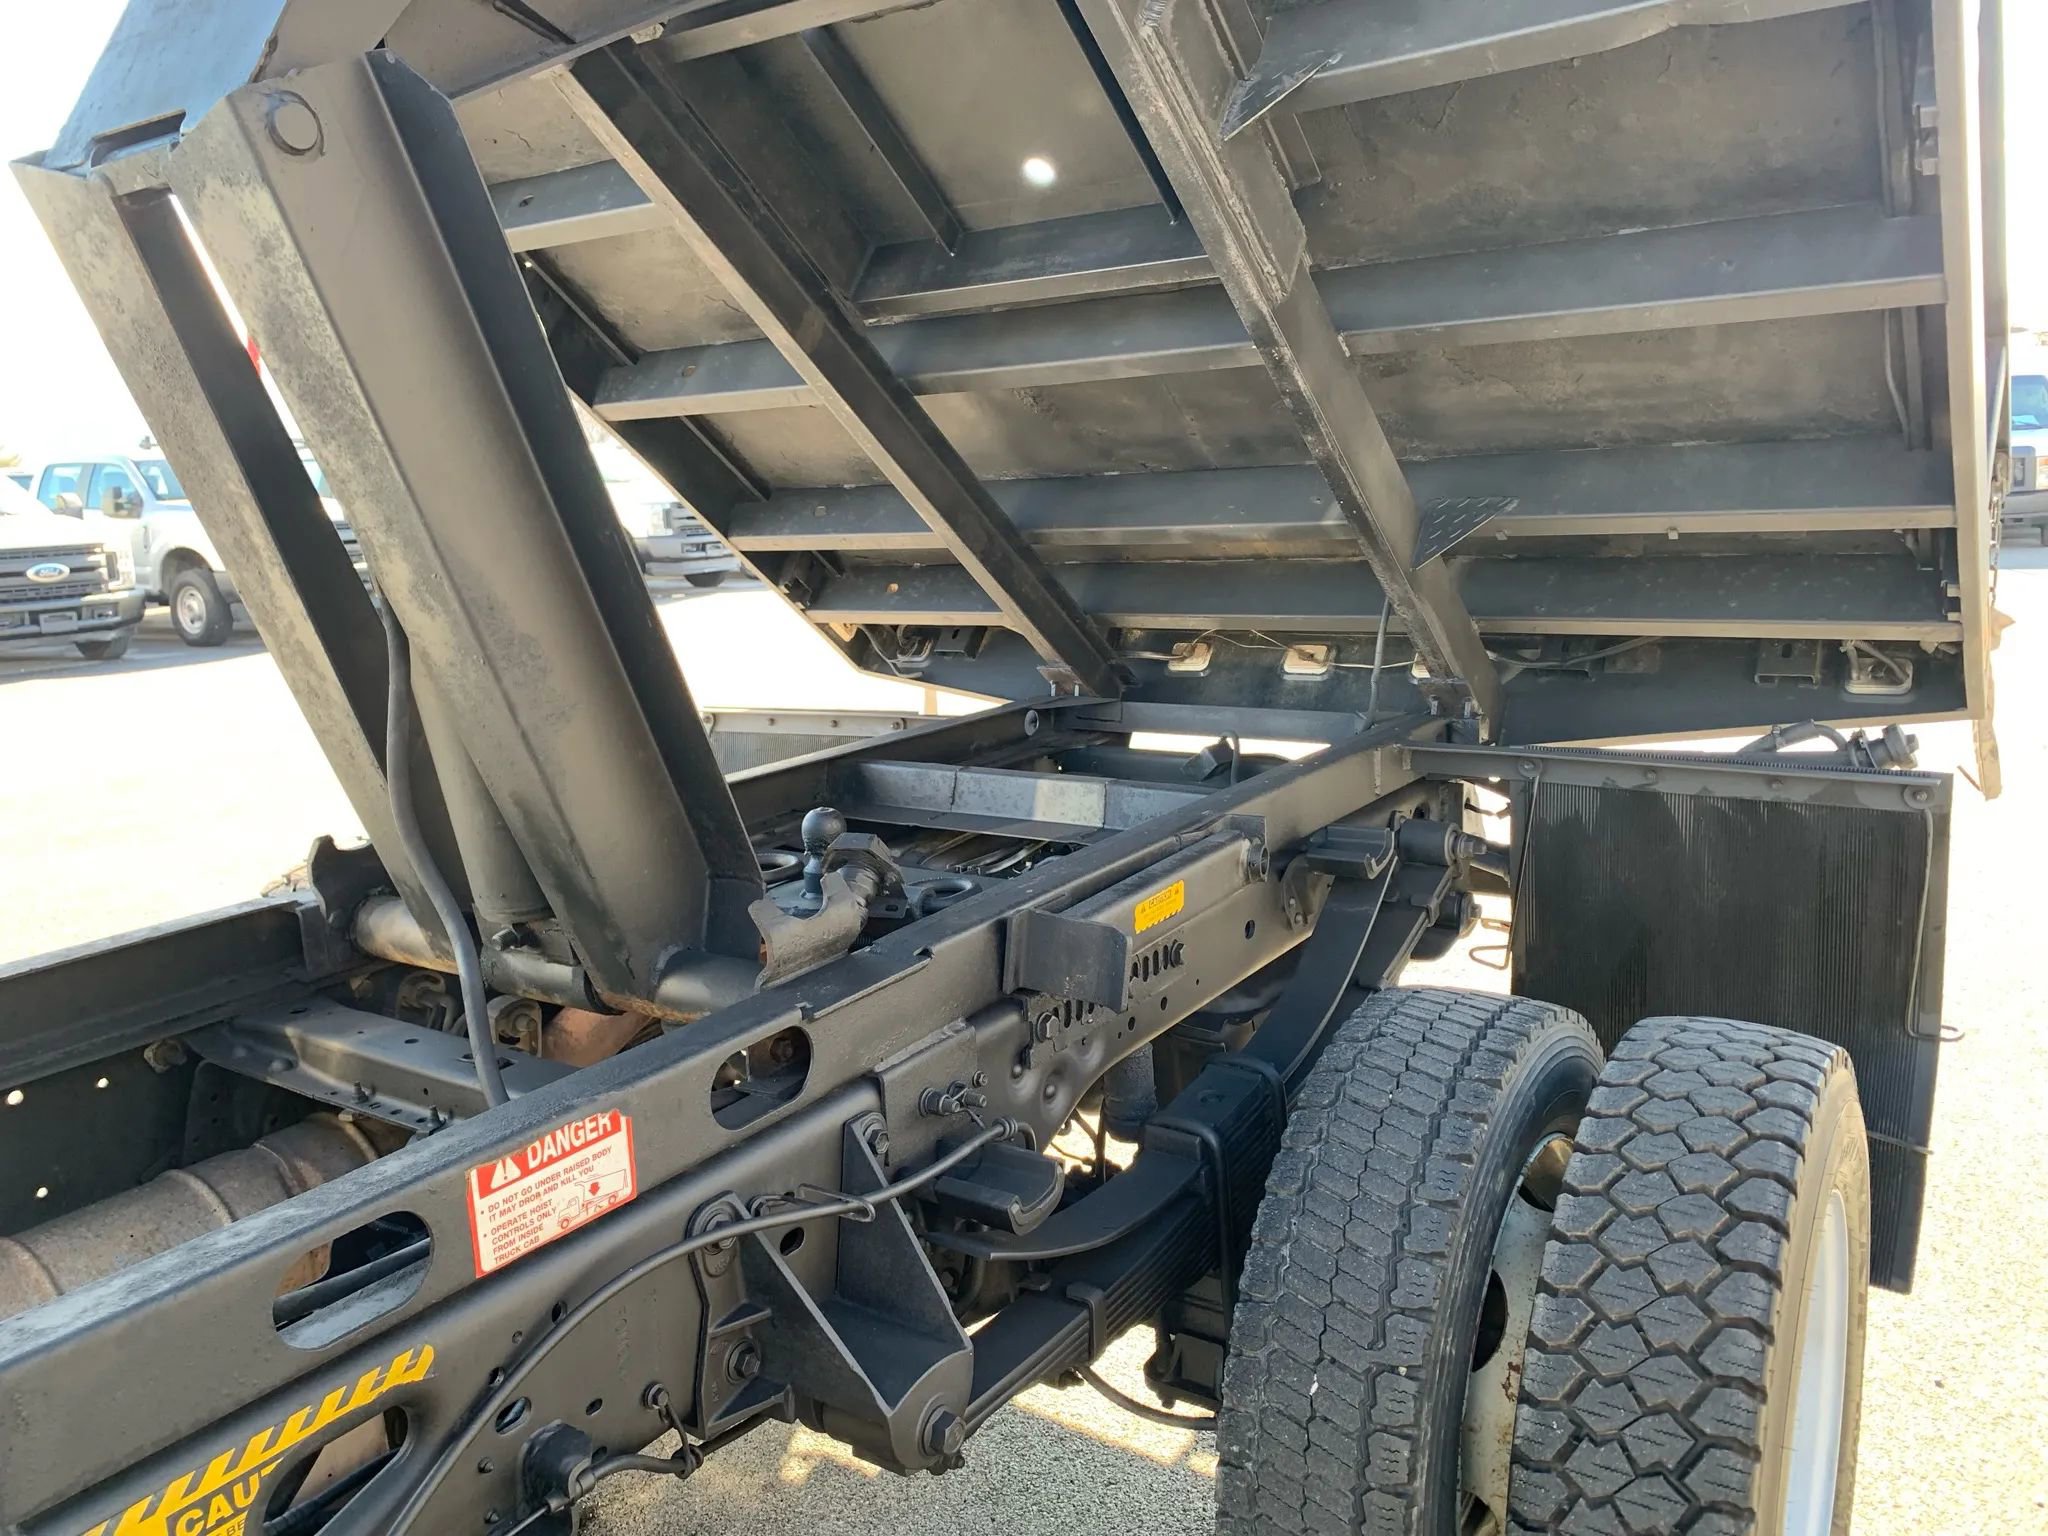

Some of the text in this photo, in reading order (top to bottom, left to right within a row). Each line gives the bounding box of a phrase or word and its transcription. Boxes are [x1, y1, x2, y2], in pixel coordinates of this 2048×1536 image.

[527, 1113, 612, 1169] DANGER
[488, 1145, 612, 1213] DO NOT GO UNDER RAISED BODY
[489, 1213, 496, 1222] IT
[499, 1204, 516, 1218] MAY
[543, 1183, 558, 1195] AND
[561, 1174, 577, 1187] KILL
[579, 1165, 594, 1177] YOU
[491, 1199, 553, 1235] OPERATE HOIST
[492, 1207, 557, 1245] CONTROLS ONLY
[493, 1223, 544, 1255] FROM INSIDE
[494, 1235, 540, 1264] TRUCK CAB
